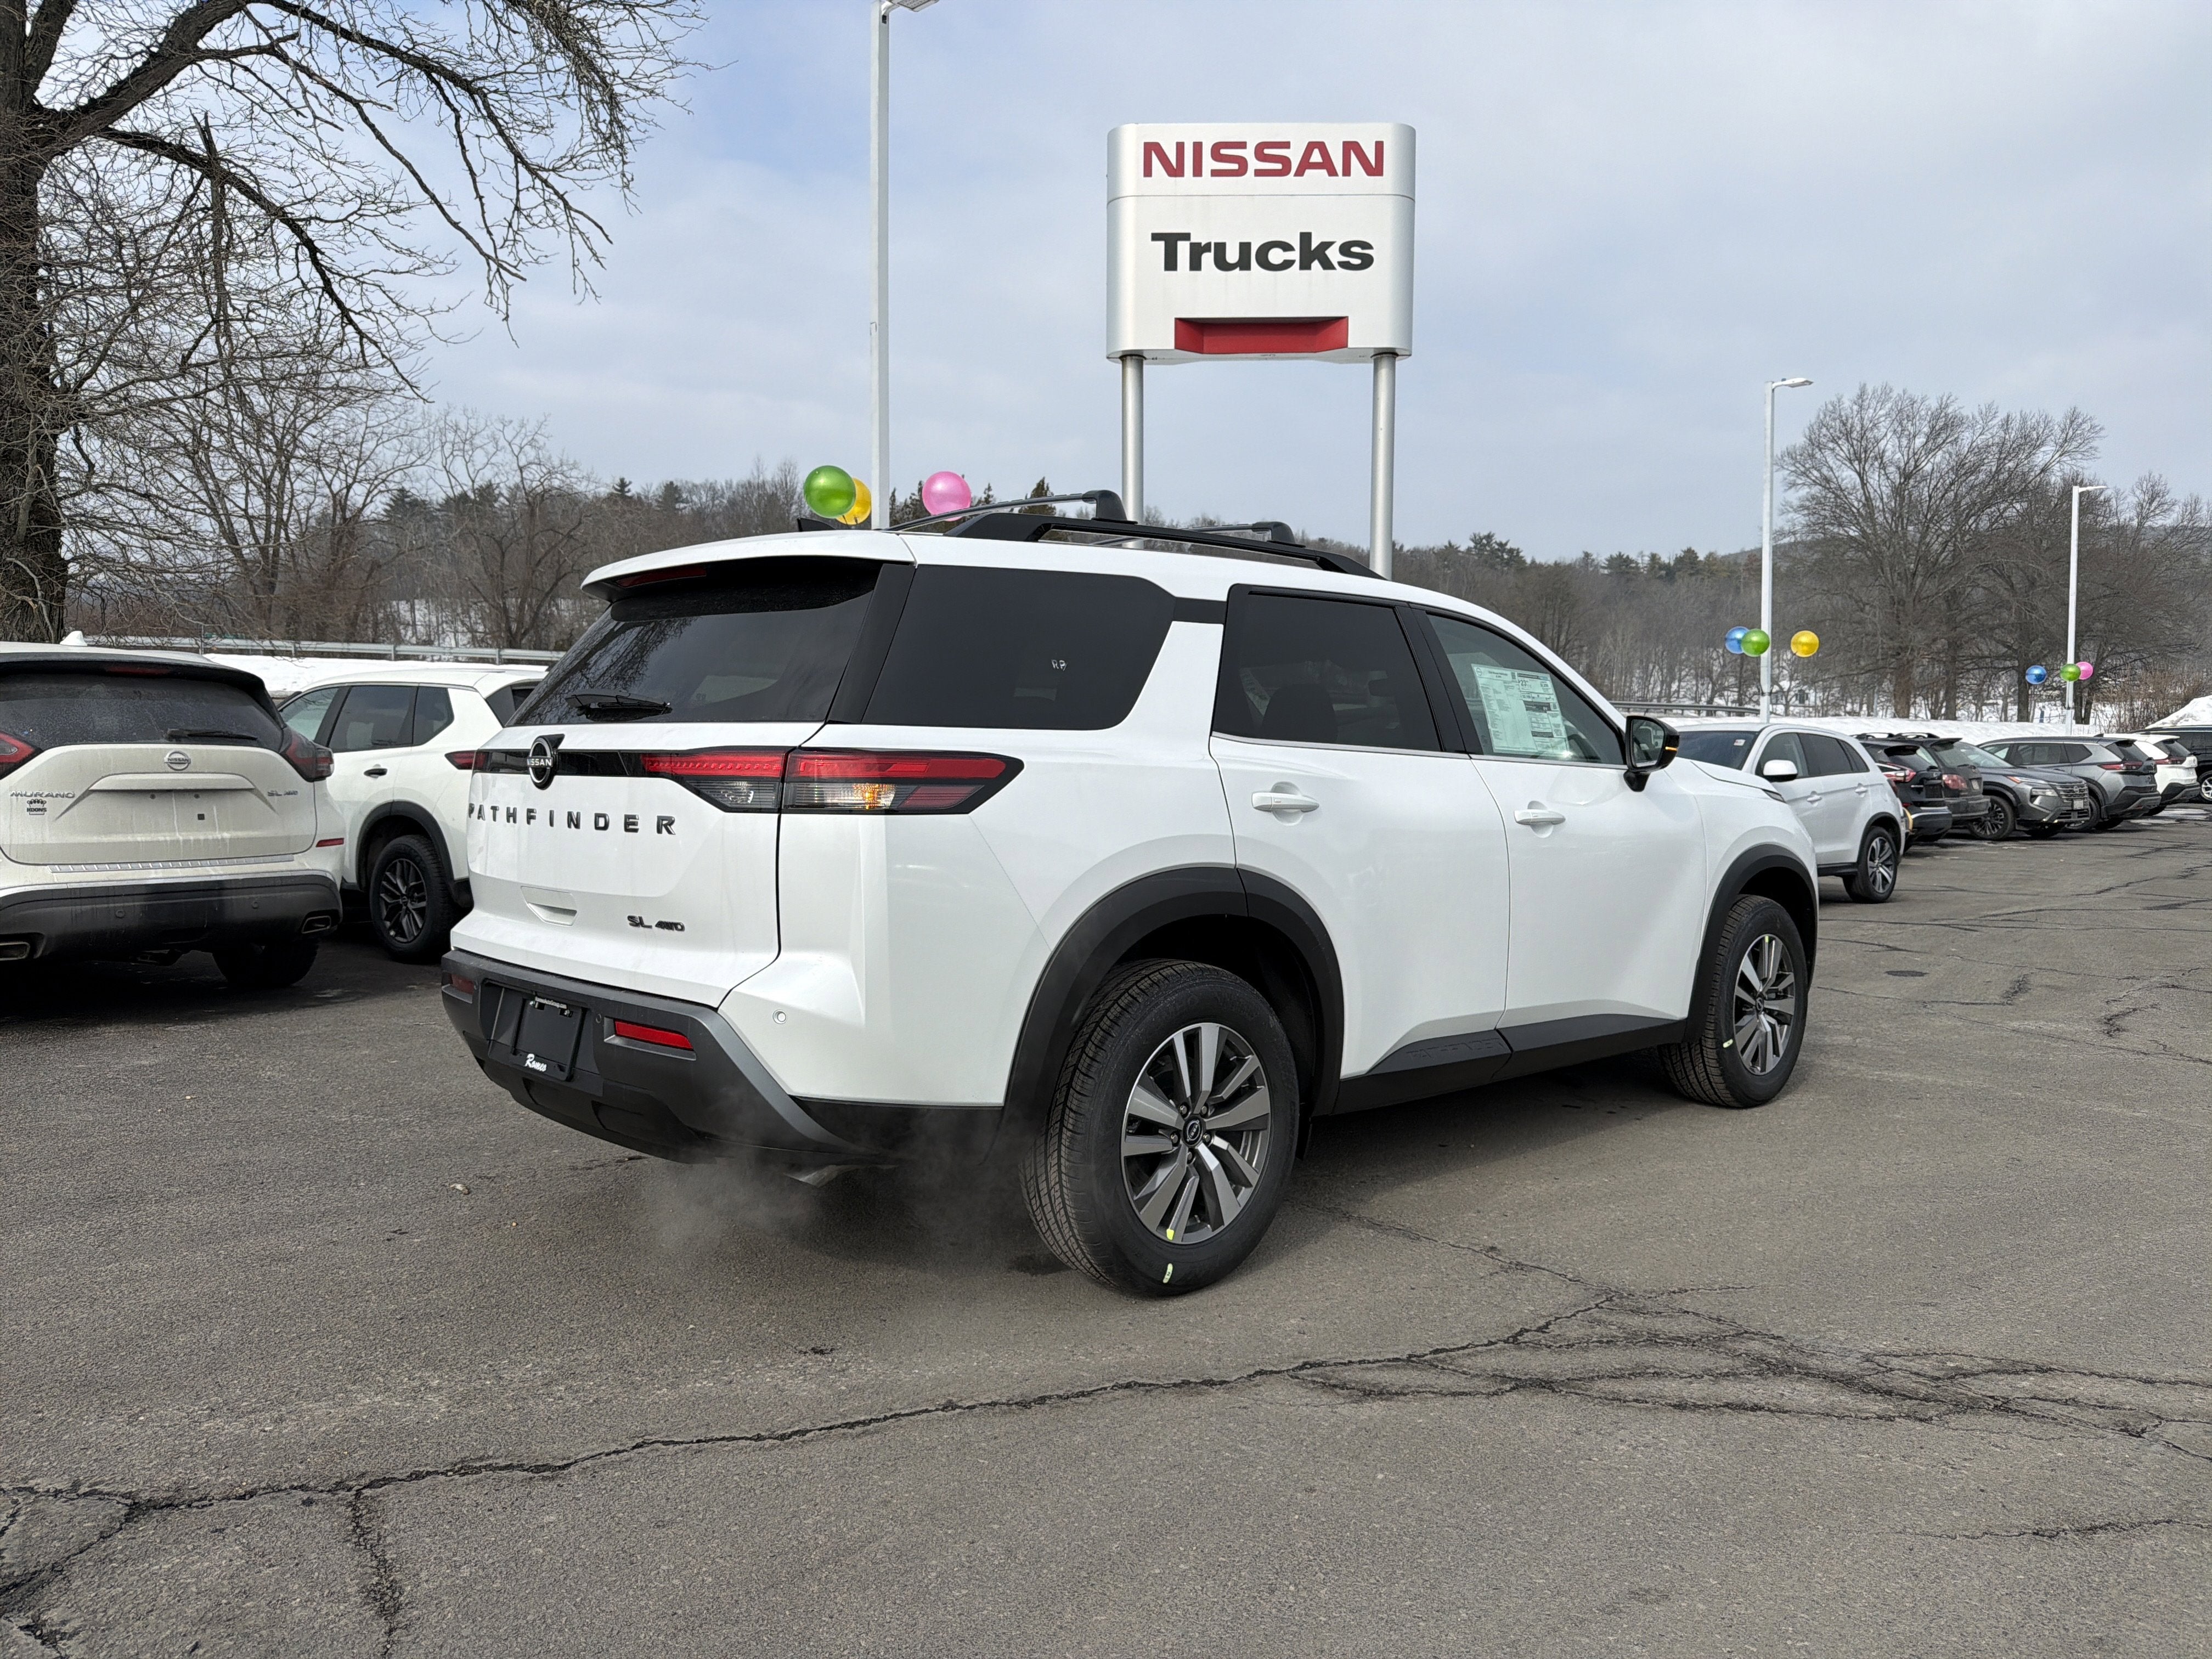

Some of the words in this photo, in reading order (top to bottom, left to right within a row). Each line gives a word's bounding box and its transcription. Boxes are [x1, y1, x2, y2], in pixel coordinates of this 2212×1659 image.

[1143, 140, 1384, 177] NISSAN
[1150, 232, 1374, 272] Trucks
[468, 803, 676, 836] PATHFINDER
[627, 916, 652, 929] SL
